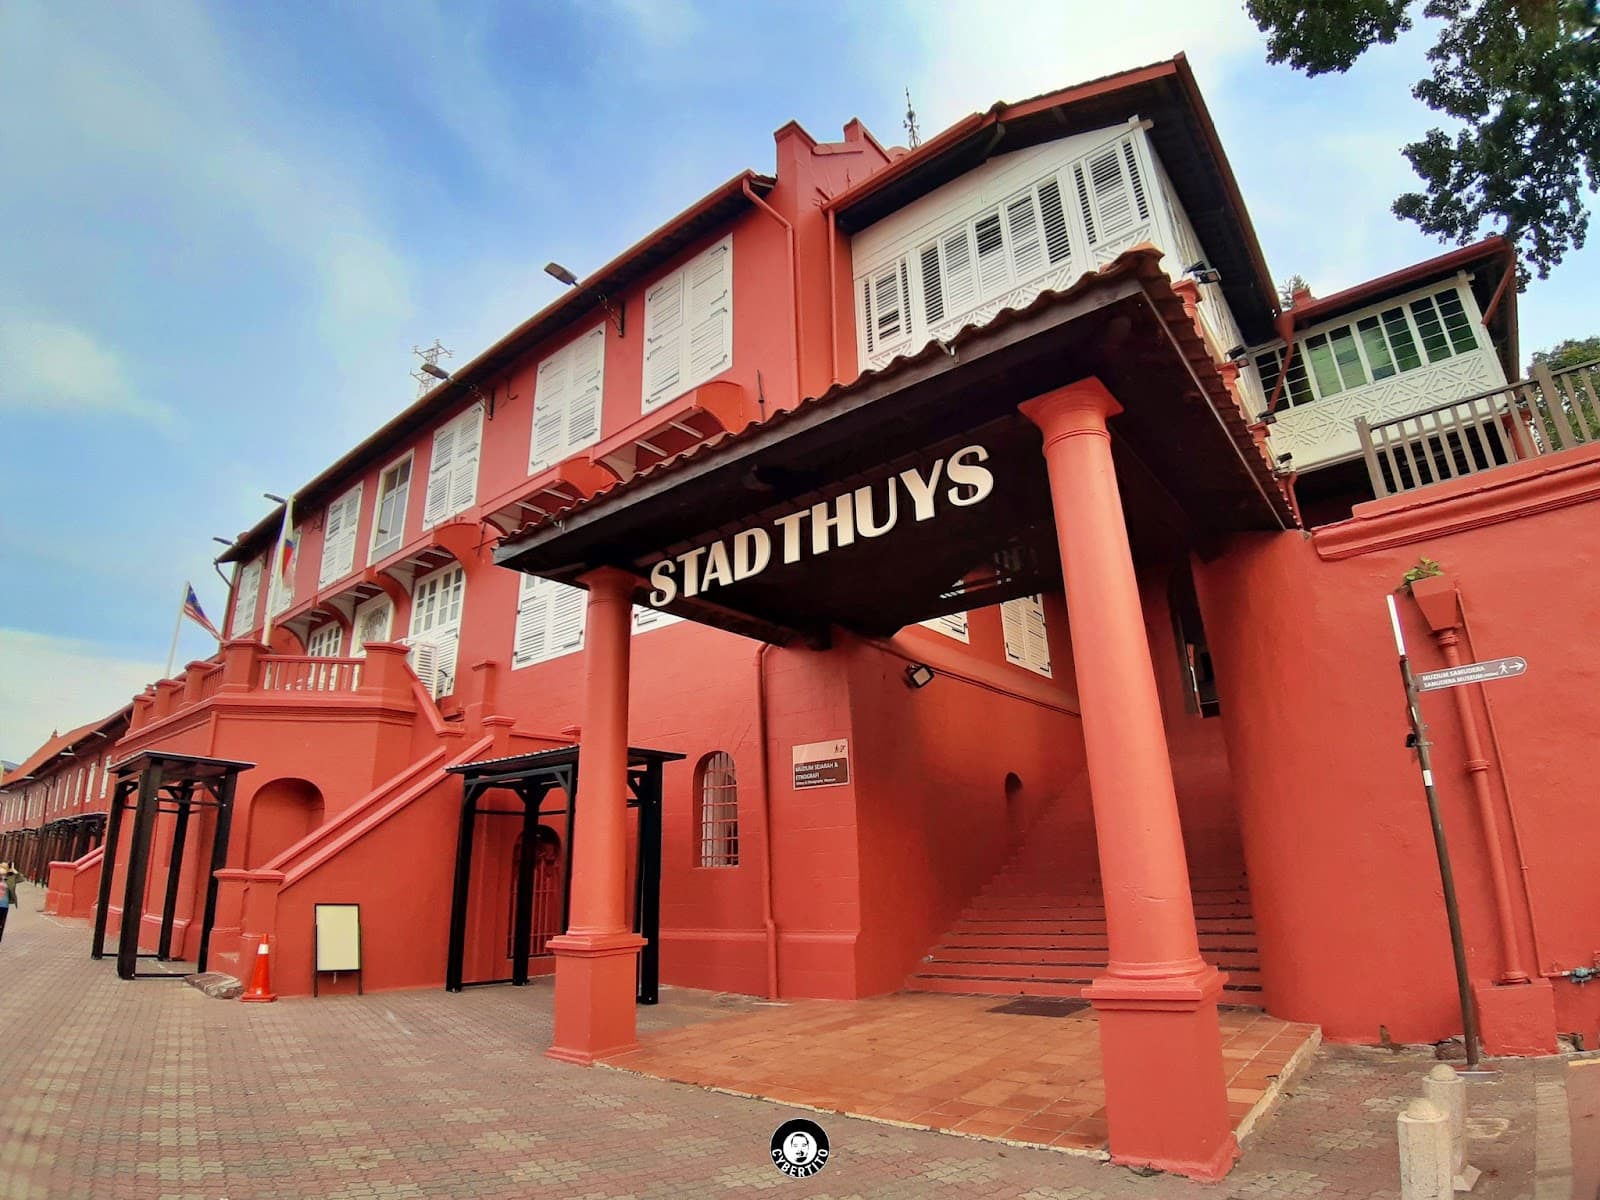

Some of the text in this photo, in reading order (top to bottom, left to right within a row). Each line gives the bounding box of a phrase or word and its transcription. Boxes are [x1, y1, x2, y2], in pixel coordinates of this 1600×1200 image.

[649, 444, 994, 607] STADTHUYS
[1422, 671, 1449, 681] MUZIUM
[1449, 666, 1485, 676] SAMUDERA
[1424, 678, 1456, 688] SAMUDERA
[1456, 673, 1484, 683] MUSEUM
